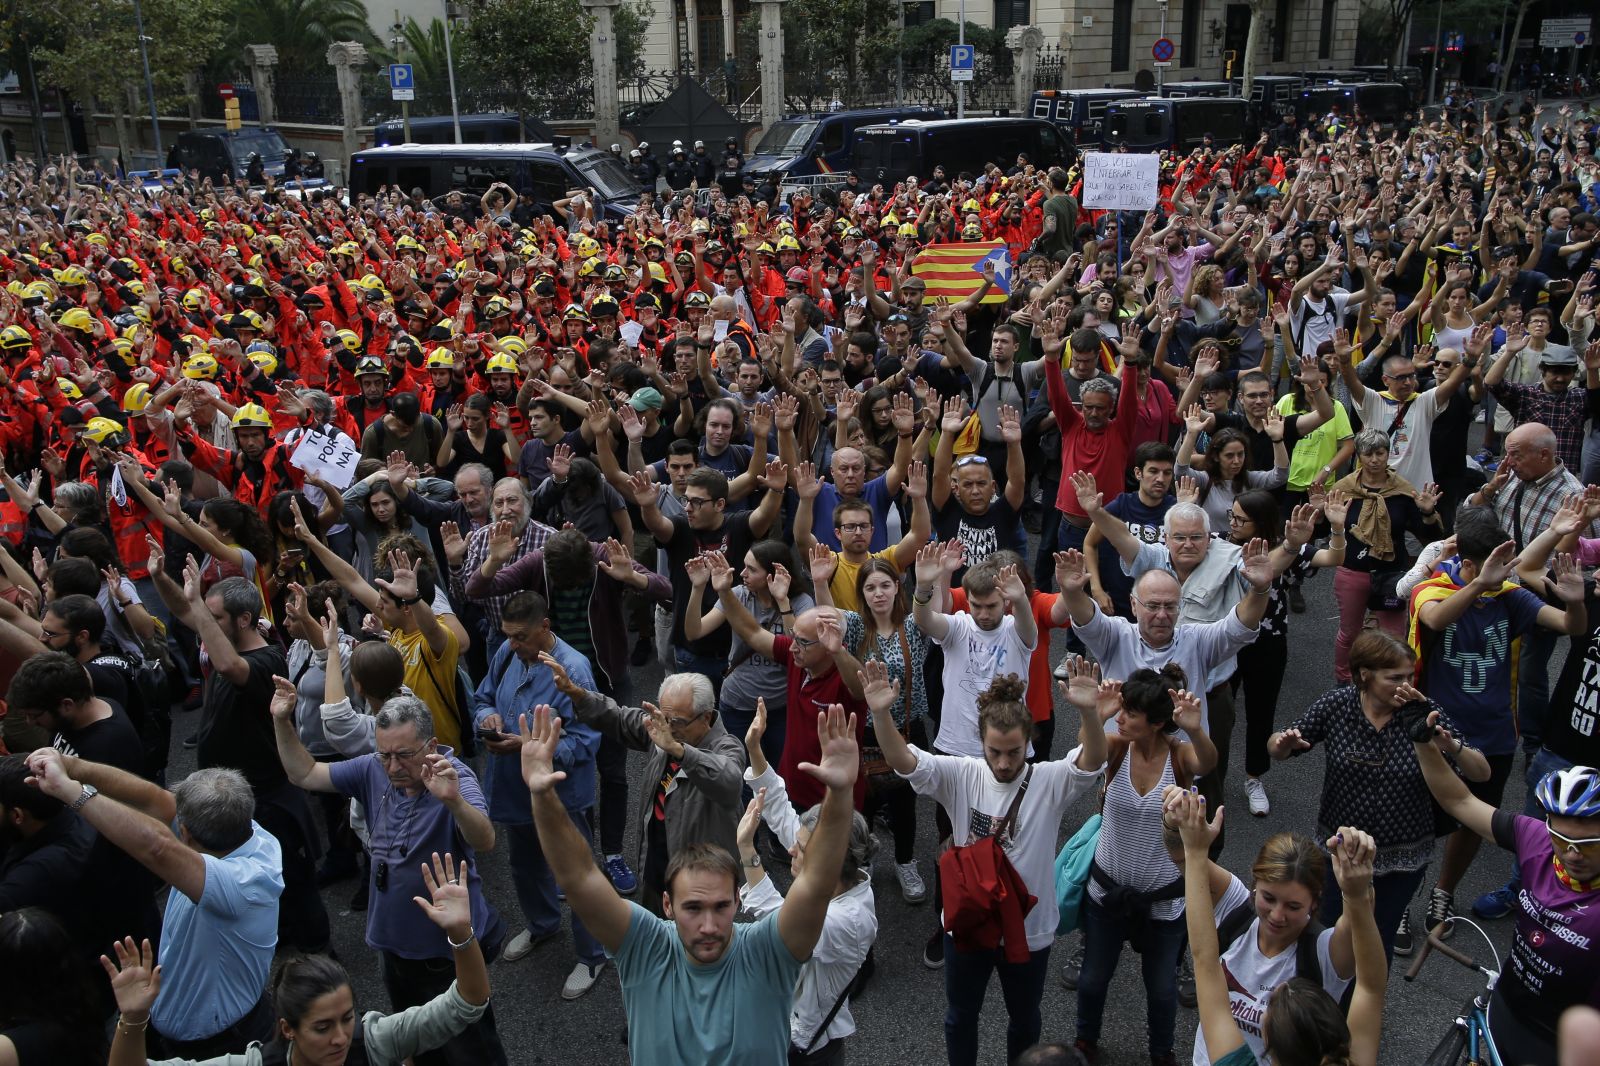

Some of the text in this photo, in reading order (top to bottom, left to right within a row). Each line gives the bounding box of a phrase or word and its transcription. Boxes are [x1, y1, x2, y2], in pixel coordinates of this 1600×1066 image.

[955, 48, 969, 66] P
[394, 67, 408, 86] P
[1087, 155, 1108, 167] ENS
[318, 438, 339, 464] POR
[92, 657, 129, 670] uperdry
[1574, 681, 1600, 715] RA
[1518, 888, 1591, 951] CASTELLBISBAL
